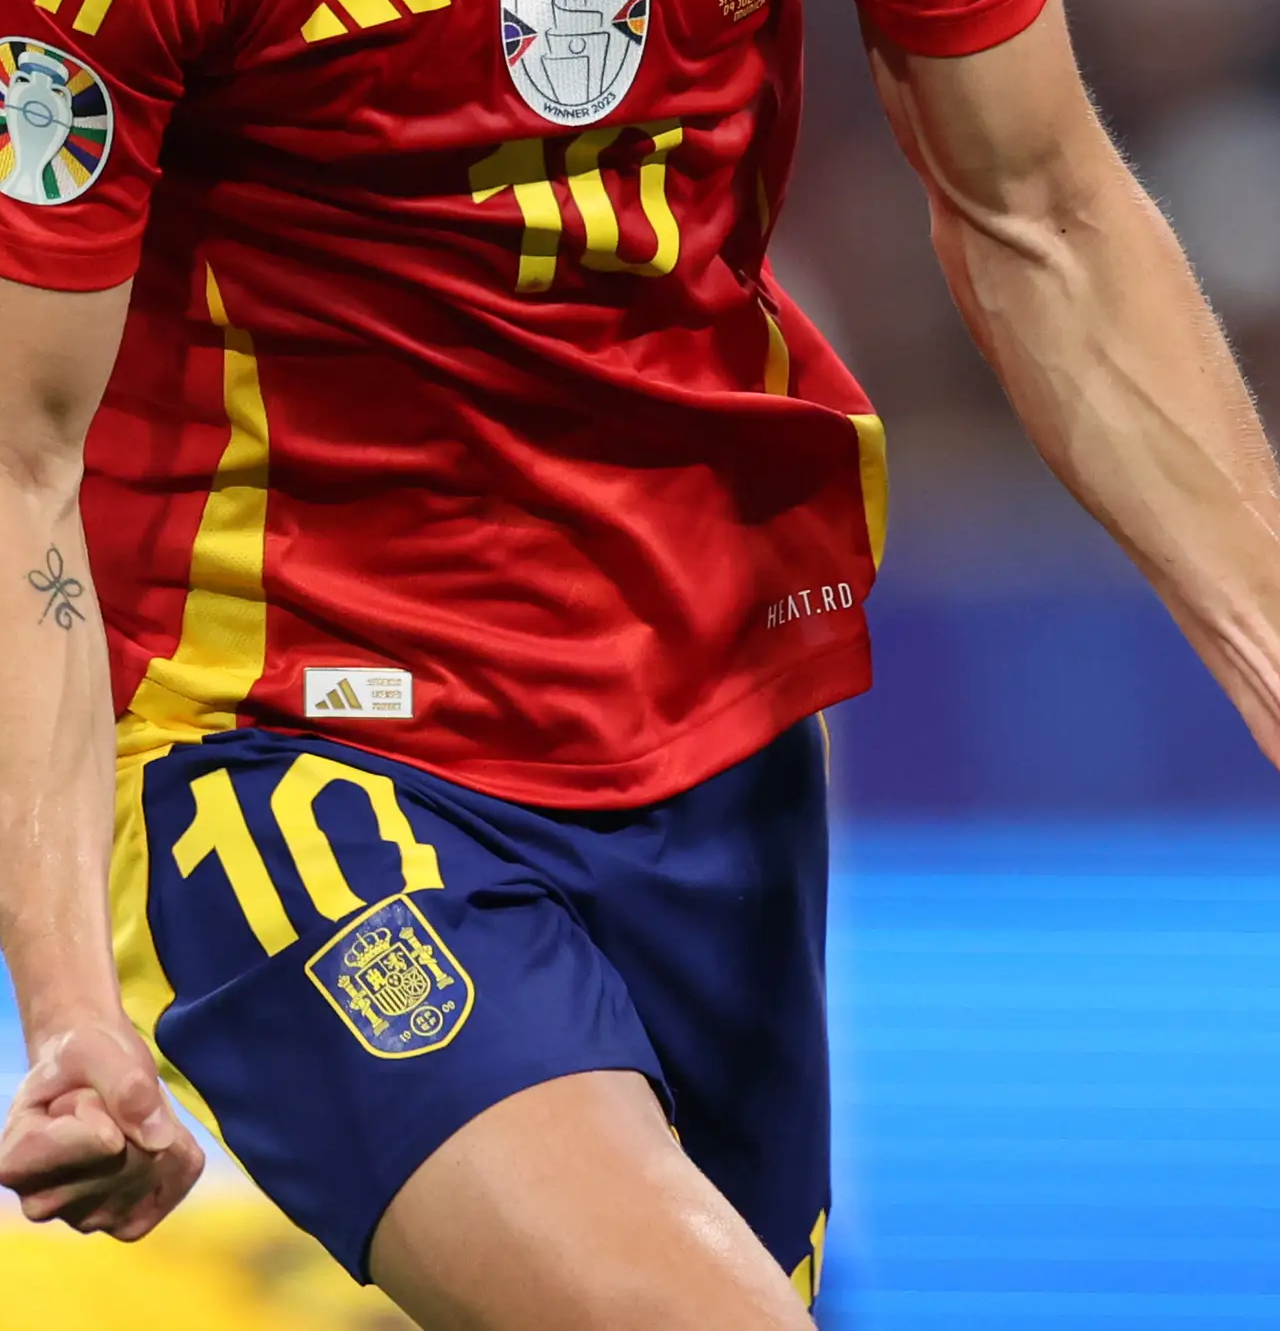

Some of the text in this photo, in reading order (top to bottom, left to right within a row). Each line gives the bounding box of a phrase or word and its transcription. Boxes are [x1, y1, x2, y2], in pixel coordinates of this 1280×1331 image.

[543, 92, 616, 119] WINNER 2023
[468, 117, 683, 294] 10
[172, 752, 445, 958] 10
